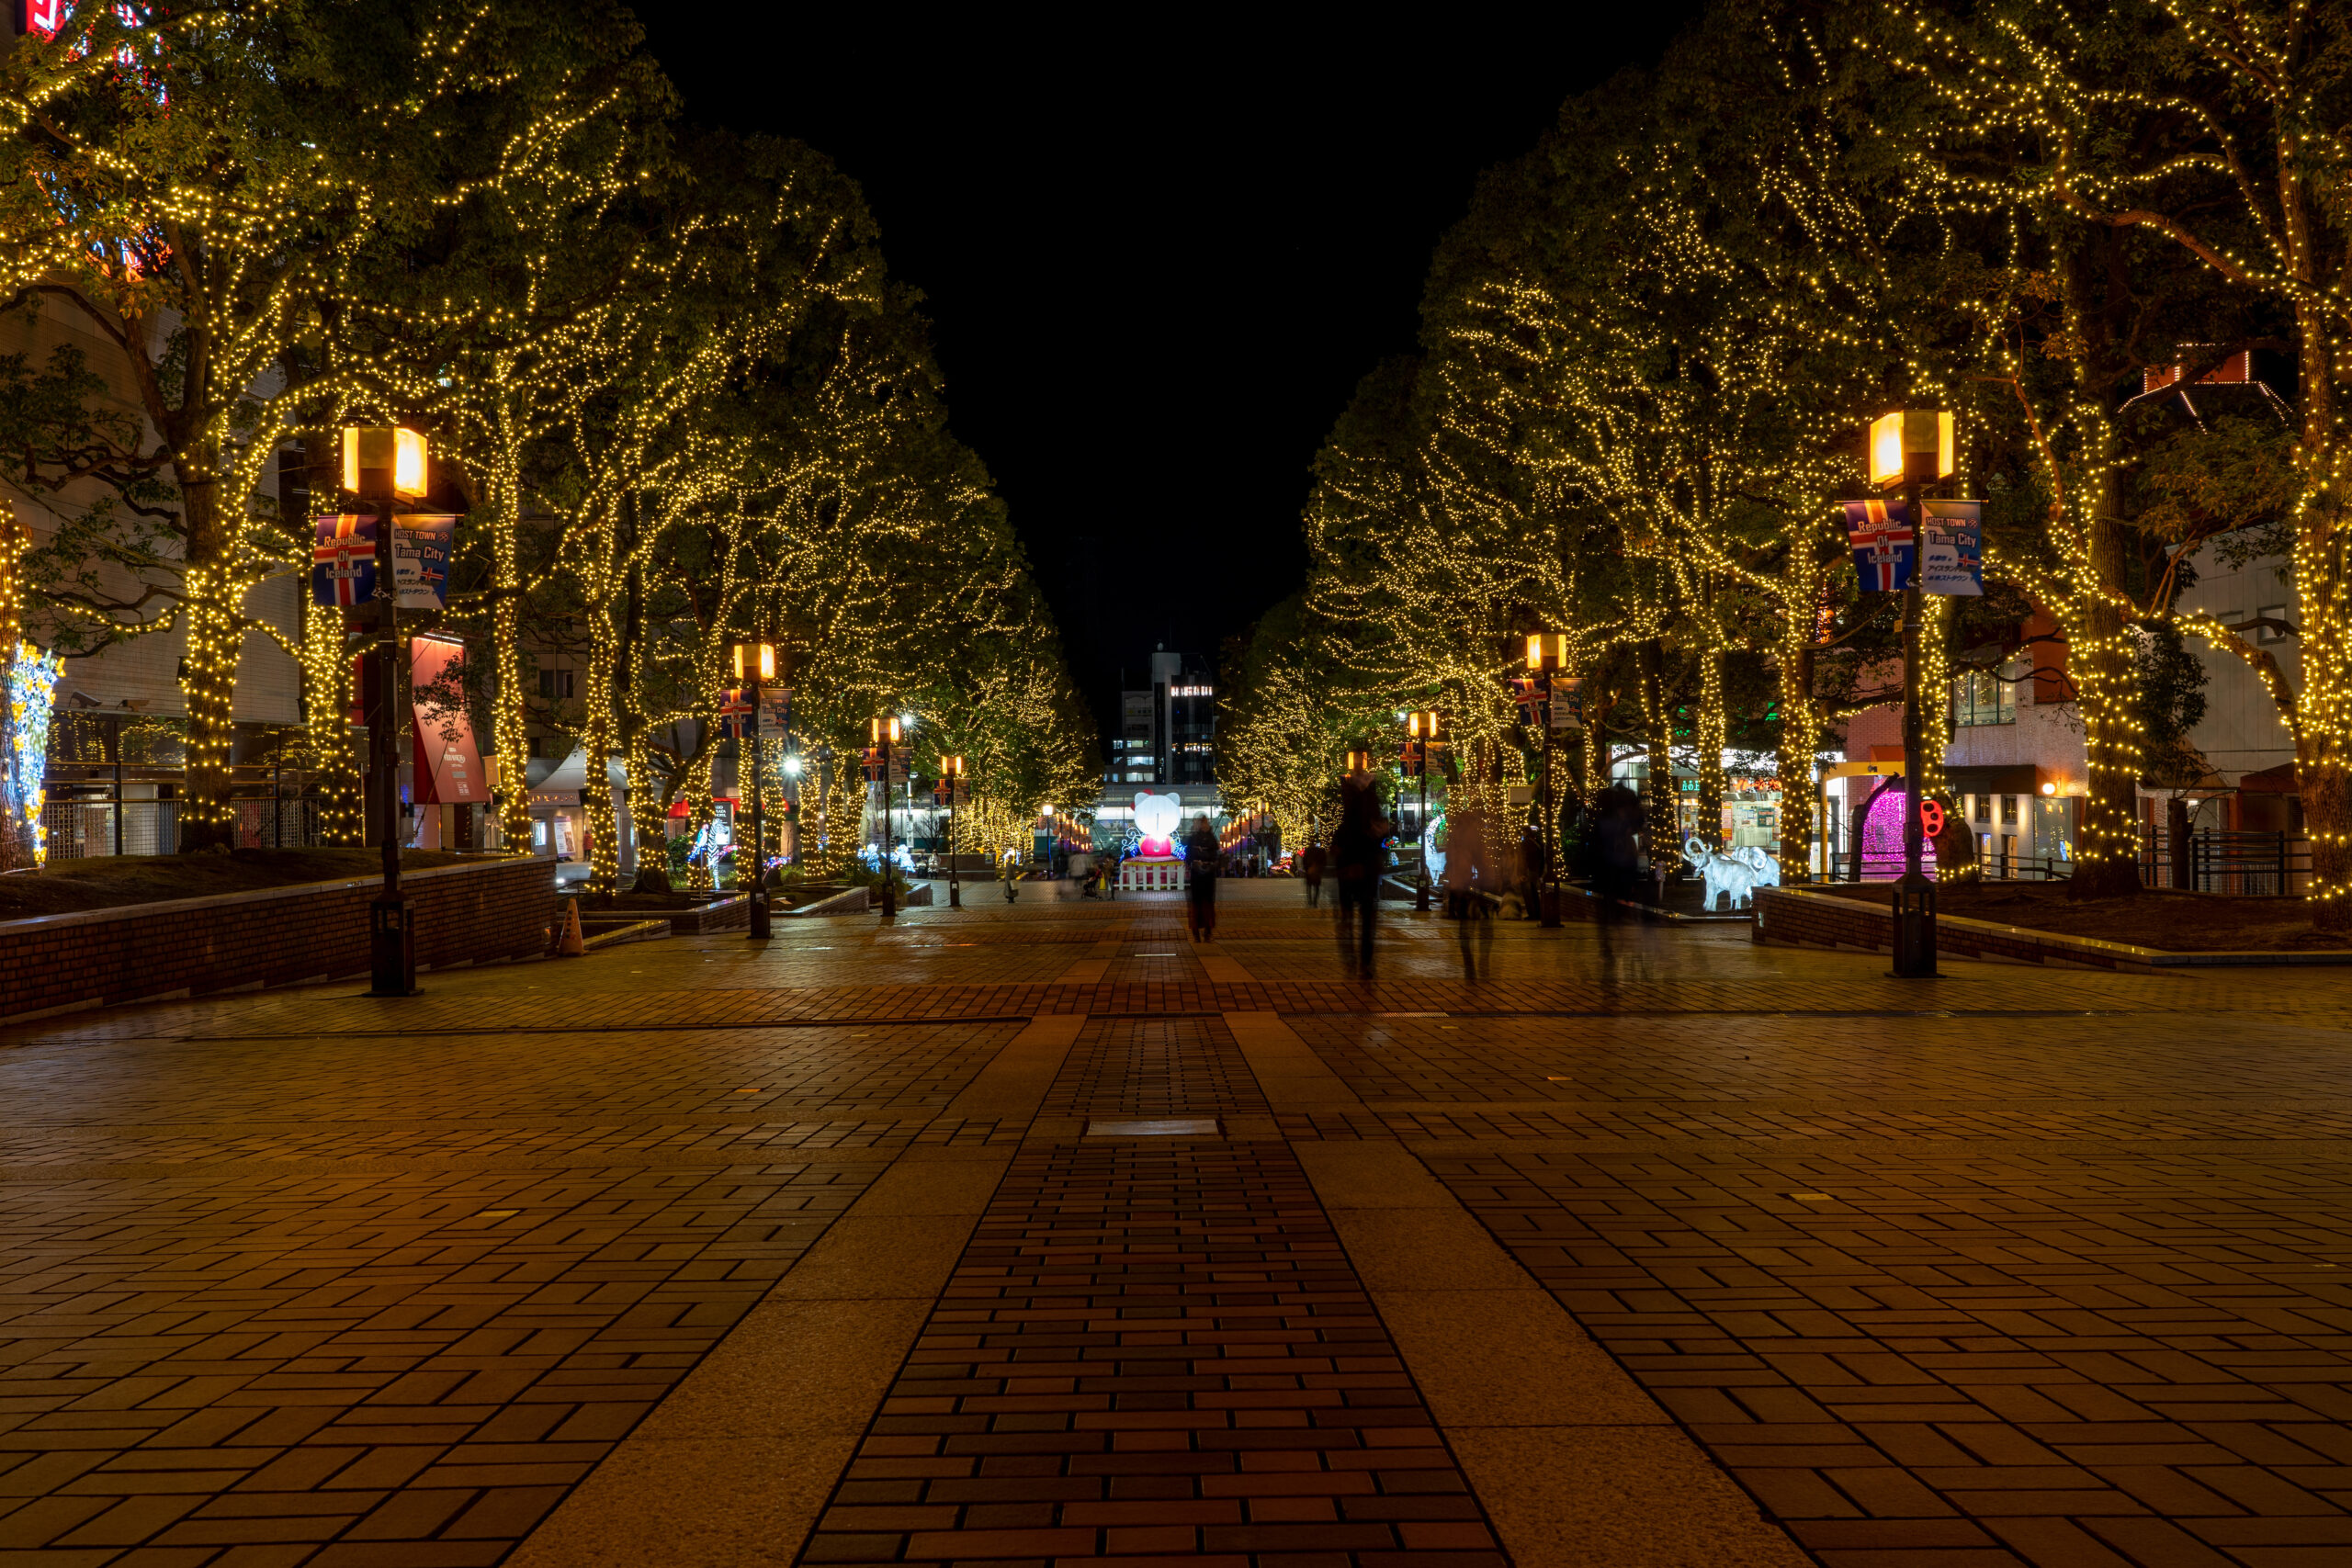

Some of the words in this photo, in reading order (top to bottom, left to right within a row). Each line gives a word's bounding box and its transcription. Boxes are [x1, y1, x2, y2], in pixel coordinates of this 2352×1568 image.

[1858, 518, 1903, 533] Republic
[1927, 517, 1945, 527] HOST
[1946, 518, 1966, 527] TOWN
[324, 534, 366, 547] Republic
[395, 529, 413, 539] HOST
[415, 530, 436, 540] TOWN
[1928, 531, 1955, 546] Tama
[1958, 532, 1976, 547] City
[1877, 536, 1889, 547] Of
[338, 550, 348, 562] Of
[395, 544, 421, 558] Tama
[424, 546, 445, 562] City
[1867, 551, 1903, 564] Iceland
[326, 566, 362, 579] Iceland
